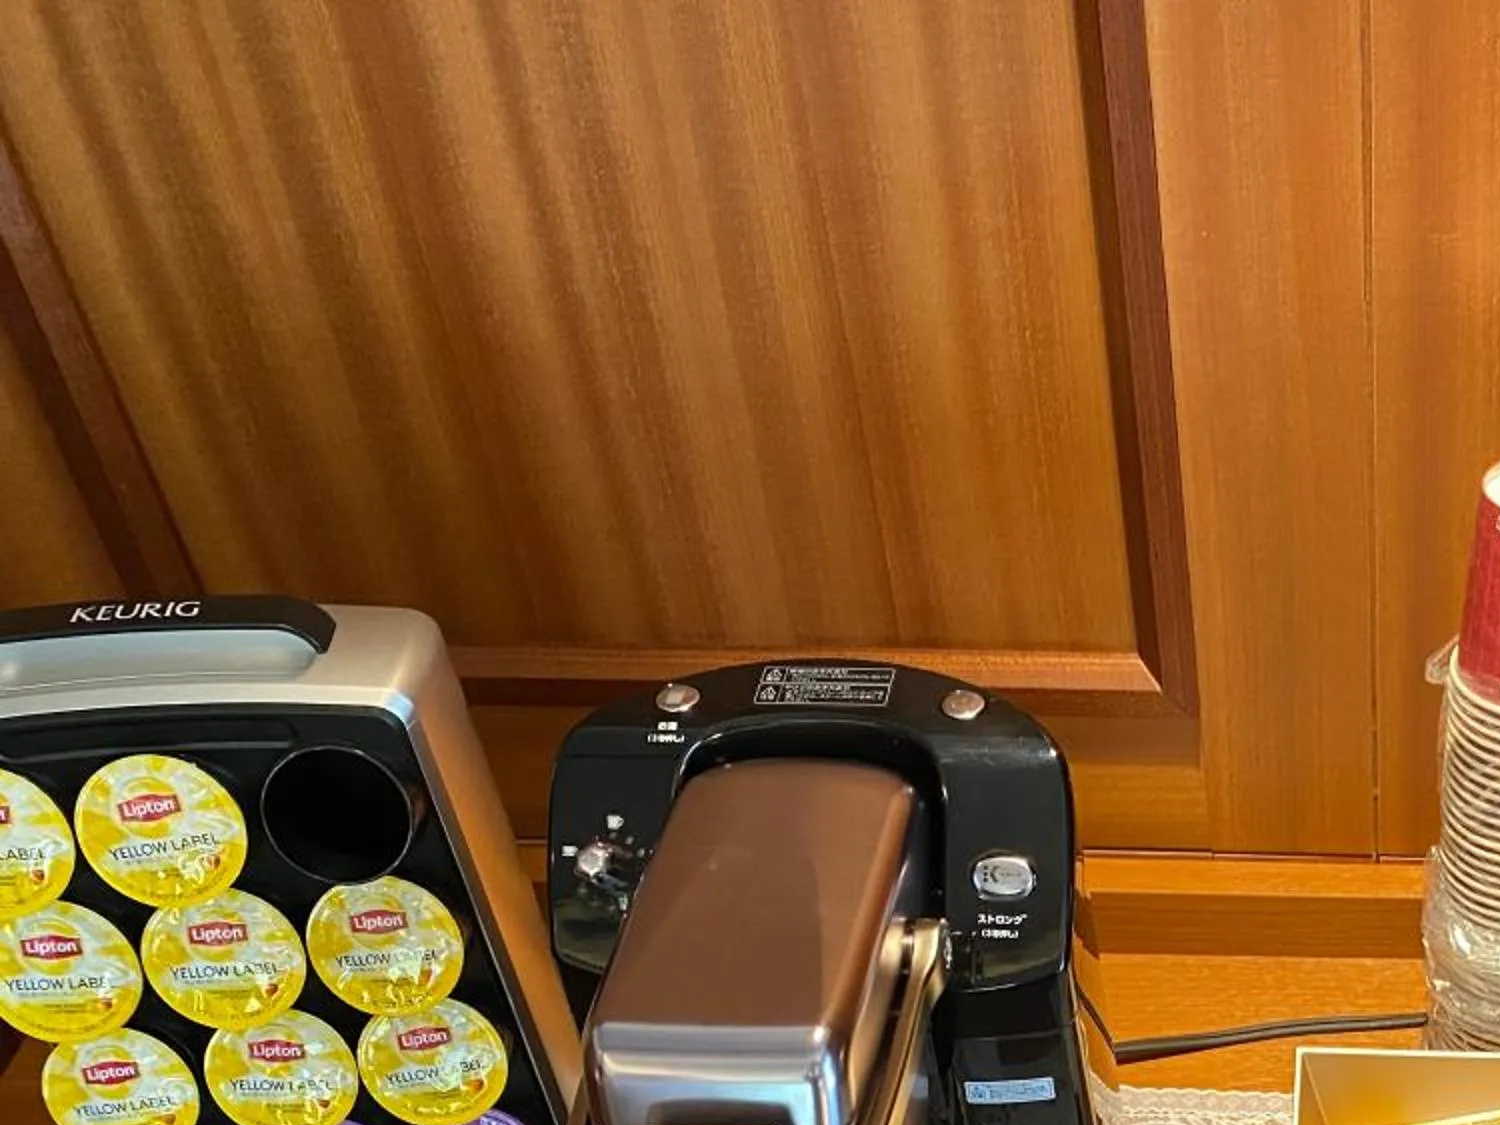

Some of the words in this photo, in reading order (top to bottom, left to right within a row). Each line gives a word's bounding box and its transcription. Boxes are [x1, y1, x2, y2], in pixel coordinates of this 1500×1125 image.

[69, 601, 201, 623] KEURIG
[122, 796, 176, 818] Lipton
[0, 848, 46, 861] ABEL
[109, 841, 168, 861] YELLOW
[354, 913, 403, 931] Lipton
[978, 914, 1028, 925] ストロング
[190, 924, 244, 943] Lipton
[24, 937, 77, 956] Lipton
[335, 952, 390, 968] YELLOW
[170, 967, 229, 981] YELLOW
[6, 978, 64, 991] YELLOW
[400, 1030, 449, 1047] Lipton
[252, 1043, 301, 1060] Lipton
[85, 1065, 136, 1082] Lipton
[386, 1067, 440, 1085] YELLOW
[230, 1079, 284, 1091] YELLOW
[73, 1103, 128, 1118] YELLOW
